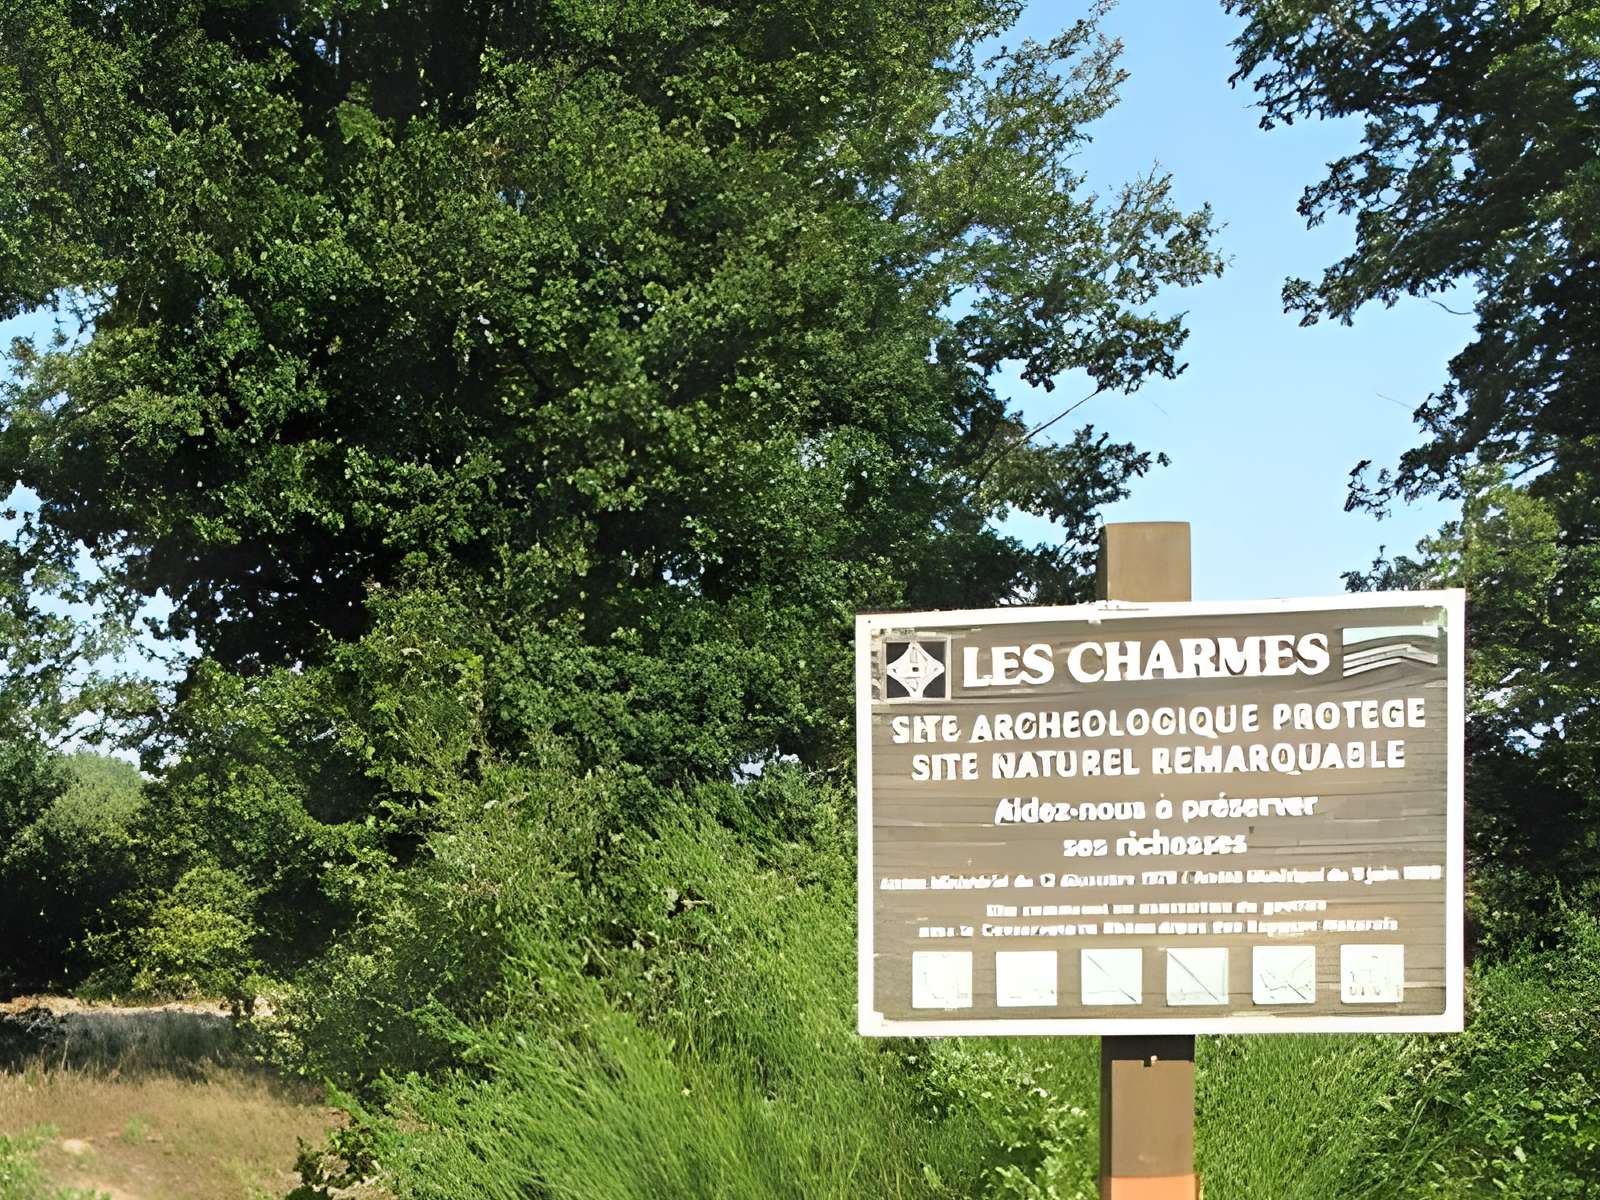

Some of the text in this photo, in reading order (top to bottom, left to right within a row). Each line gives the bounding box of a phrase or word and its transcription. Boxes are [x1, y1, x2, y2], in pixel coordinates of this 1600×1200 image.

[963, 632, 1330, 687] LES CHARMES
[892, 698, 1426, 744] SITE ARCHEOLOGIQUE PROTEGE
[911, 739, 1406, 782] SITE NATUREL REMARQUABLE
